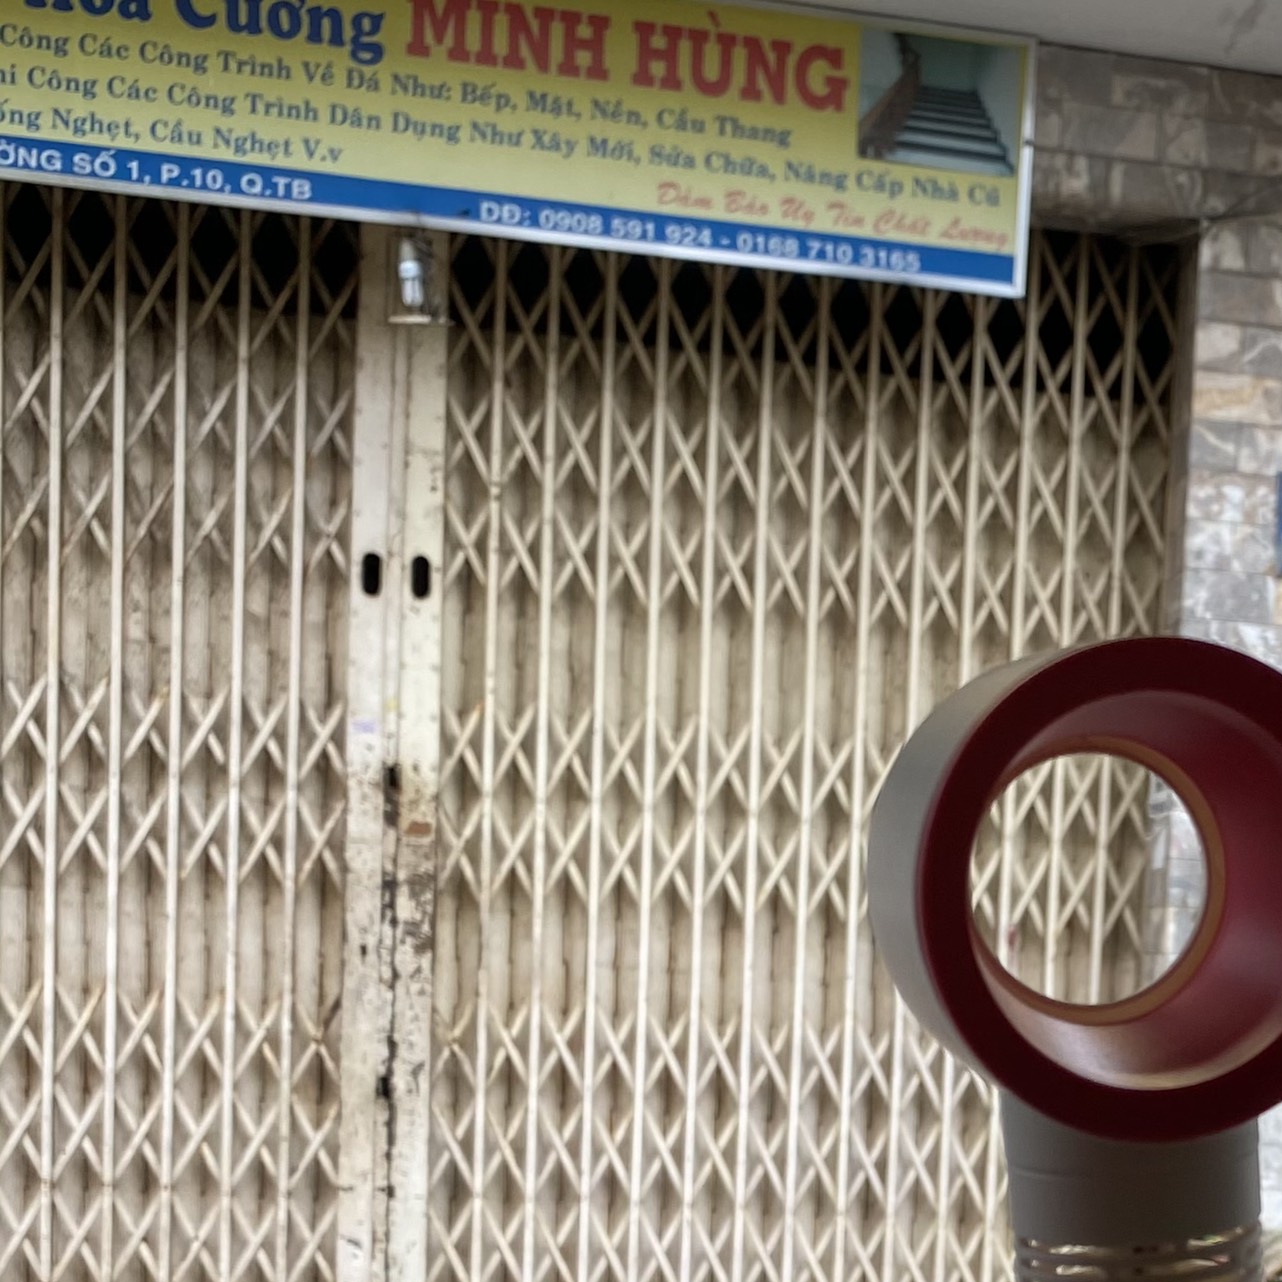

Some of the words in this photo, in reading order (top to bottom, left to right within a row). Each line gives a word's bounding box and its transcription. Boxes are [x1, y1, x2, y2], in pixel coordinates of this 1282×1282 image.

[0, 23, 69, 58] Công
[79, 33, 130, 60] Các
[139, 40, 208, 75] Công
[216, 50, 292, 80] Trình
[345, 66, 381, 93] Đá
[461, 81, 518, 113] Bếp,
[656, 106, 706, 134] Cầu
[714, 115, 793, 149] Thang
[406, 0, 610, 81] MINH
[631, 10, 848, 113] HÙNG
[28, 65, 99, 100] Công
[107, 75, 158, 102] Các
[167, 81, 237, 117] Công
[244, 92, 320, 123] Trình
[391, 110, 462, 145] Dụng
[469, 120, 525, 147] Như
[530, 128, 579, 160] Xây
[911, 175, 960, 202] Nhà
[51, 106, 141, 143] Nghẹt,
[151, 117, 203, 147] Cầu
[212, 125, 293, 161] Nghẹt
[72, 148, 118, 178] SỐ
[126, 159, 151, 186] 1,
[160, 162, 232, 194] P.10,
[239, 172, 313, 201] Q.TB
[538, 208, 604, 235] 0908
[610, 217, 656, 242] 591
[664, 223, 713, 247] 924
[806, 239, 853, 266] 710
